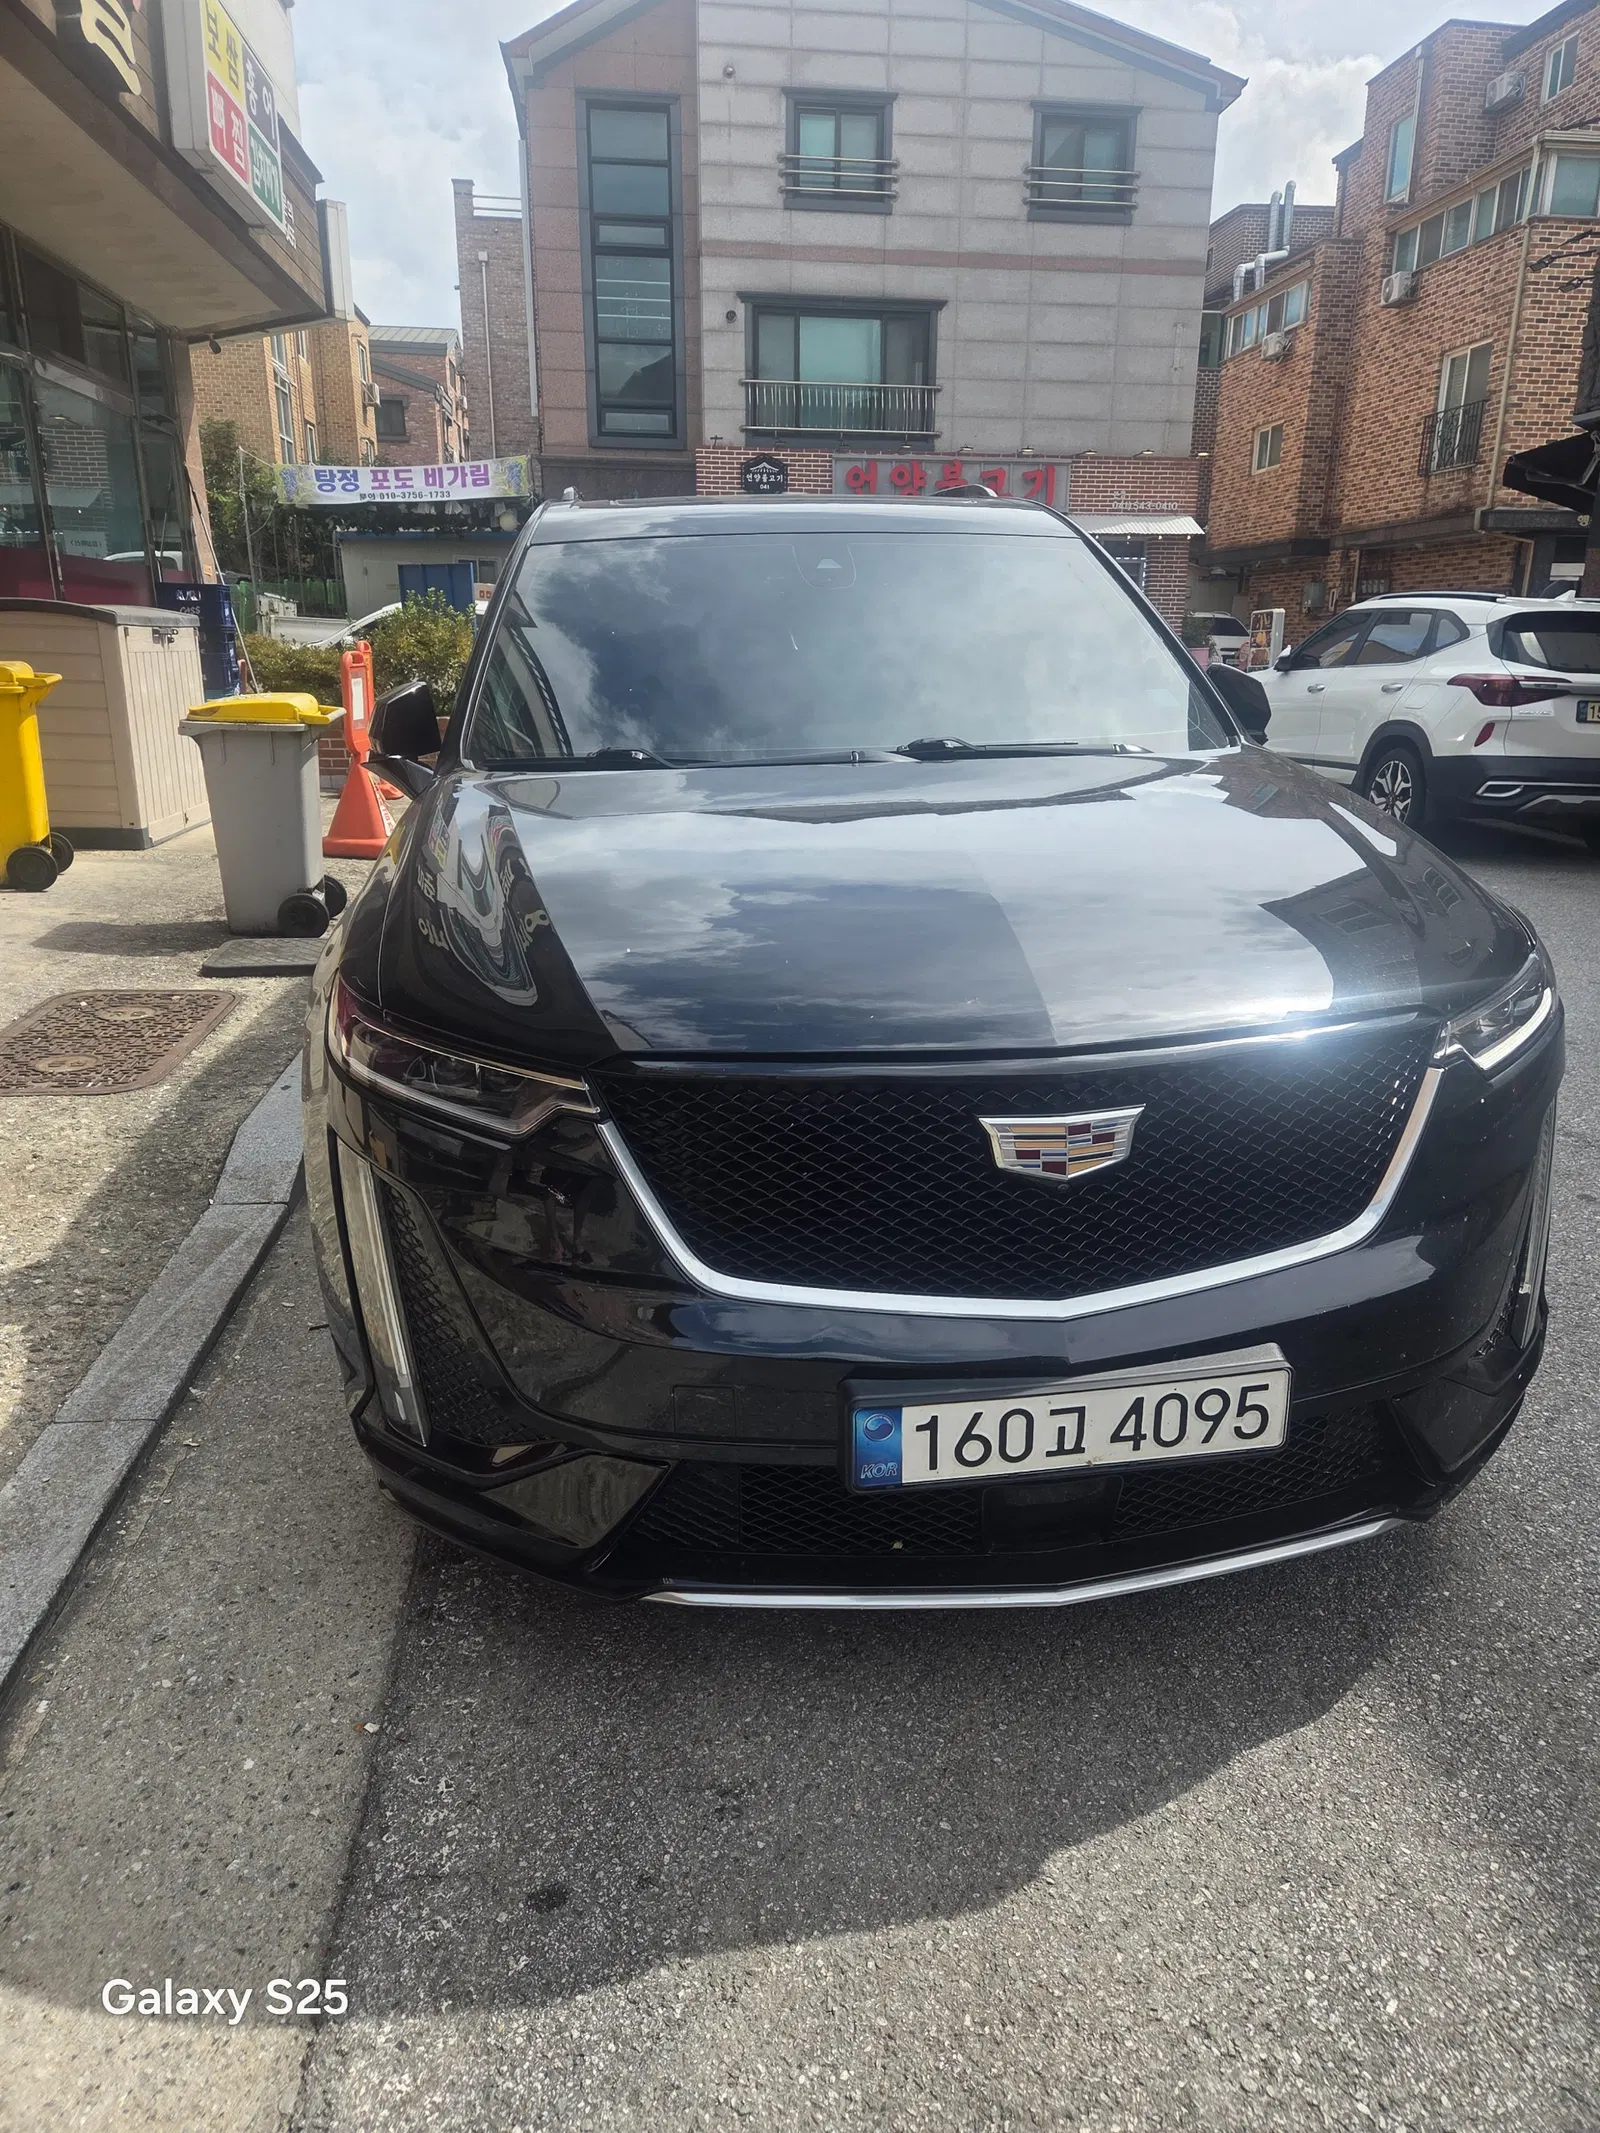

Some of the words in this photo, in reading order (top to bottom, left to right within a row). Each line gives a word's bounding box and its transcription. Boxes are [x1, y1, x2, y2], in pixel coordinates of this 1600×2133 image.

[205, 0, 240, 91] 보쌈
[246, 59, 275, 140] 홍어
[314, 468, 360, 493] 탕정
[370, 468, 415, 491] 포도
[423, 463, 491, 490] 비가림
[746, 473, 783, 483] 언양불고기
[915, 1406, 1087, 1471] 160고
[1110, 1383, 1270, 1452] 4095
[860, 1462, 898, 1479] KOR
